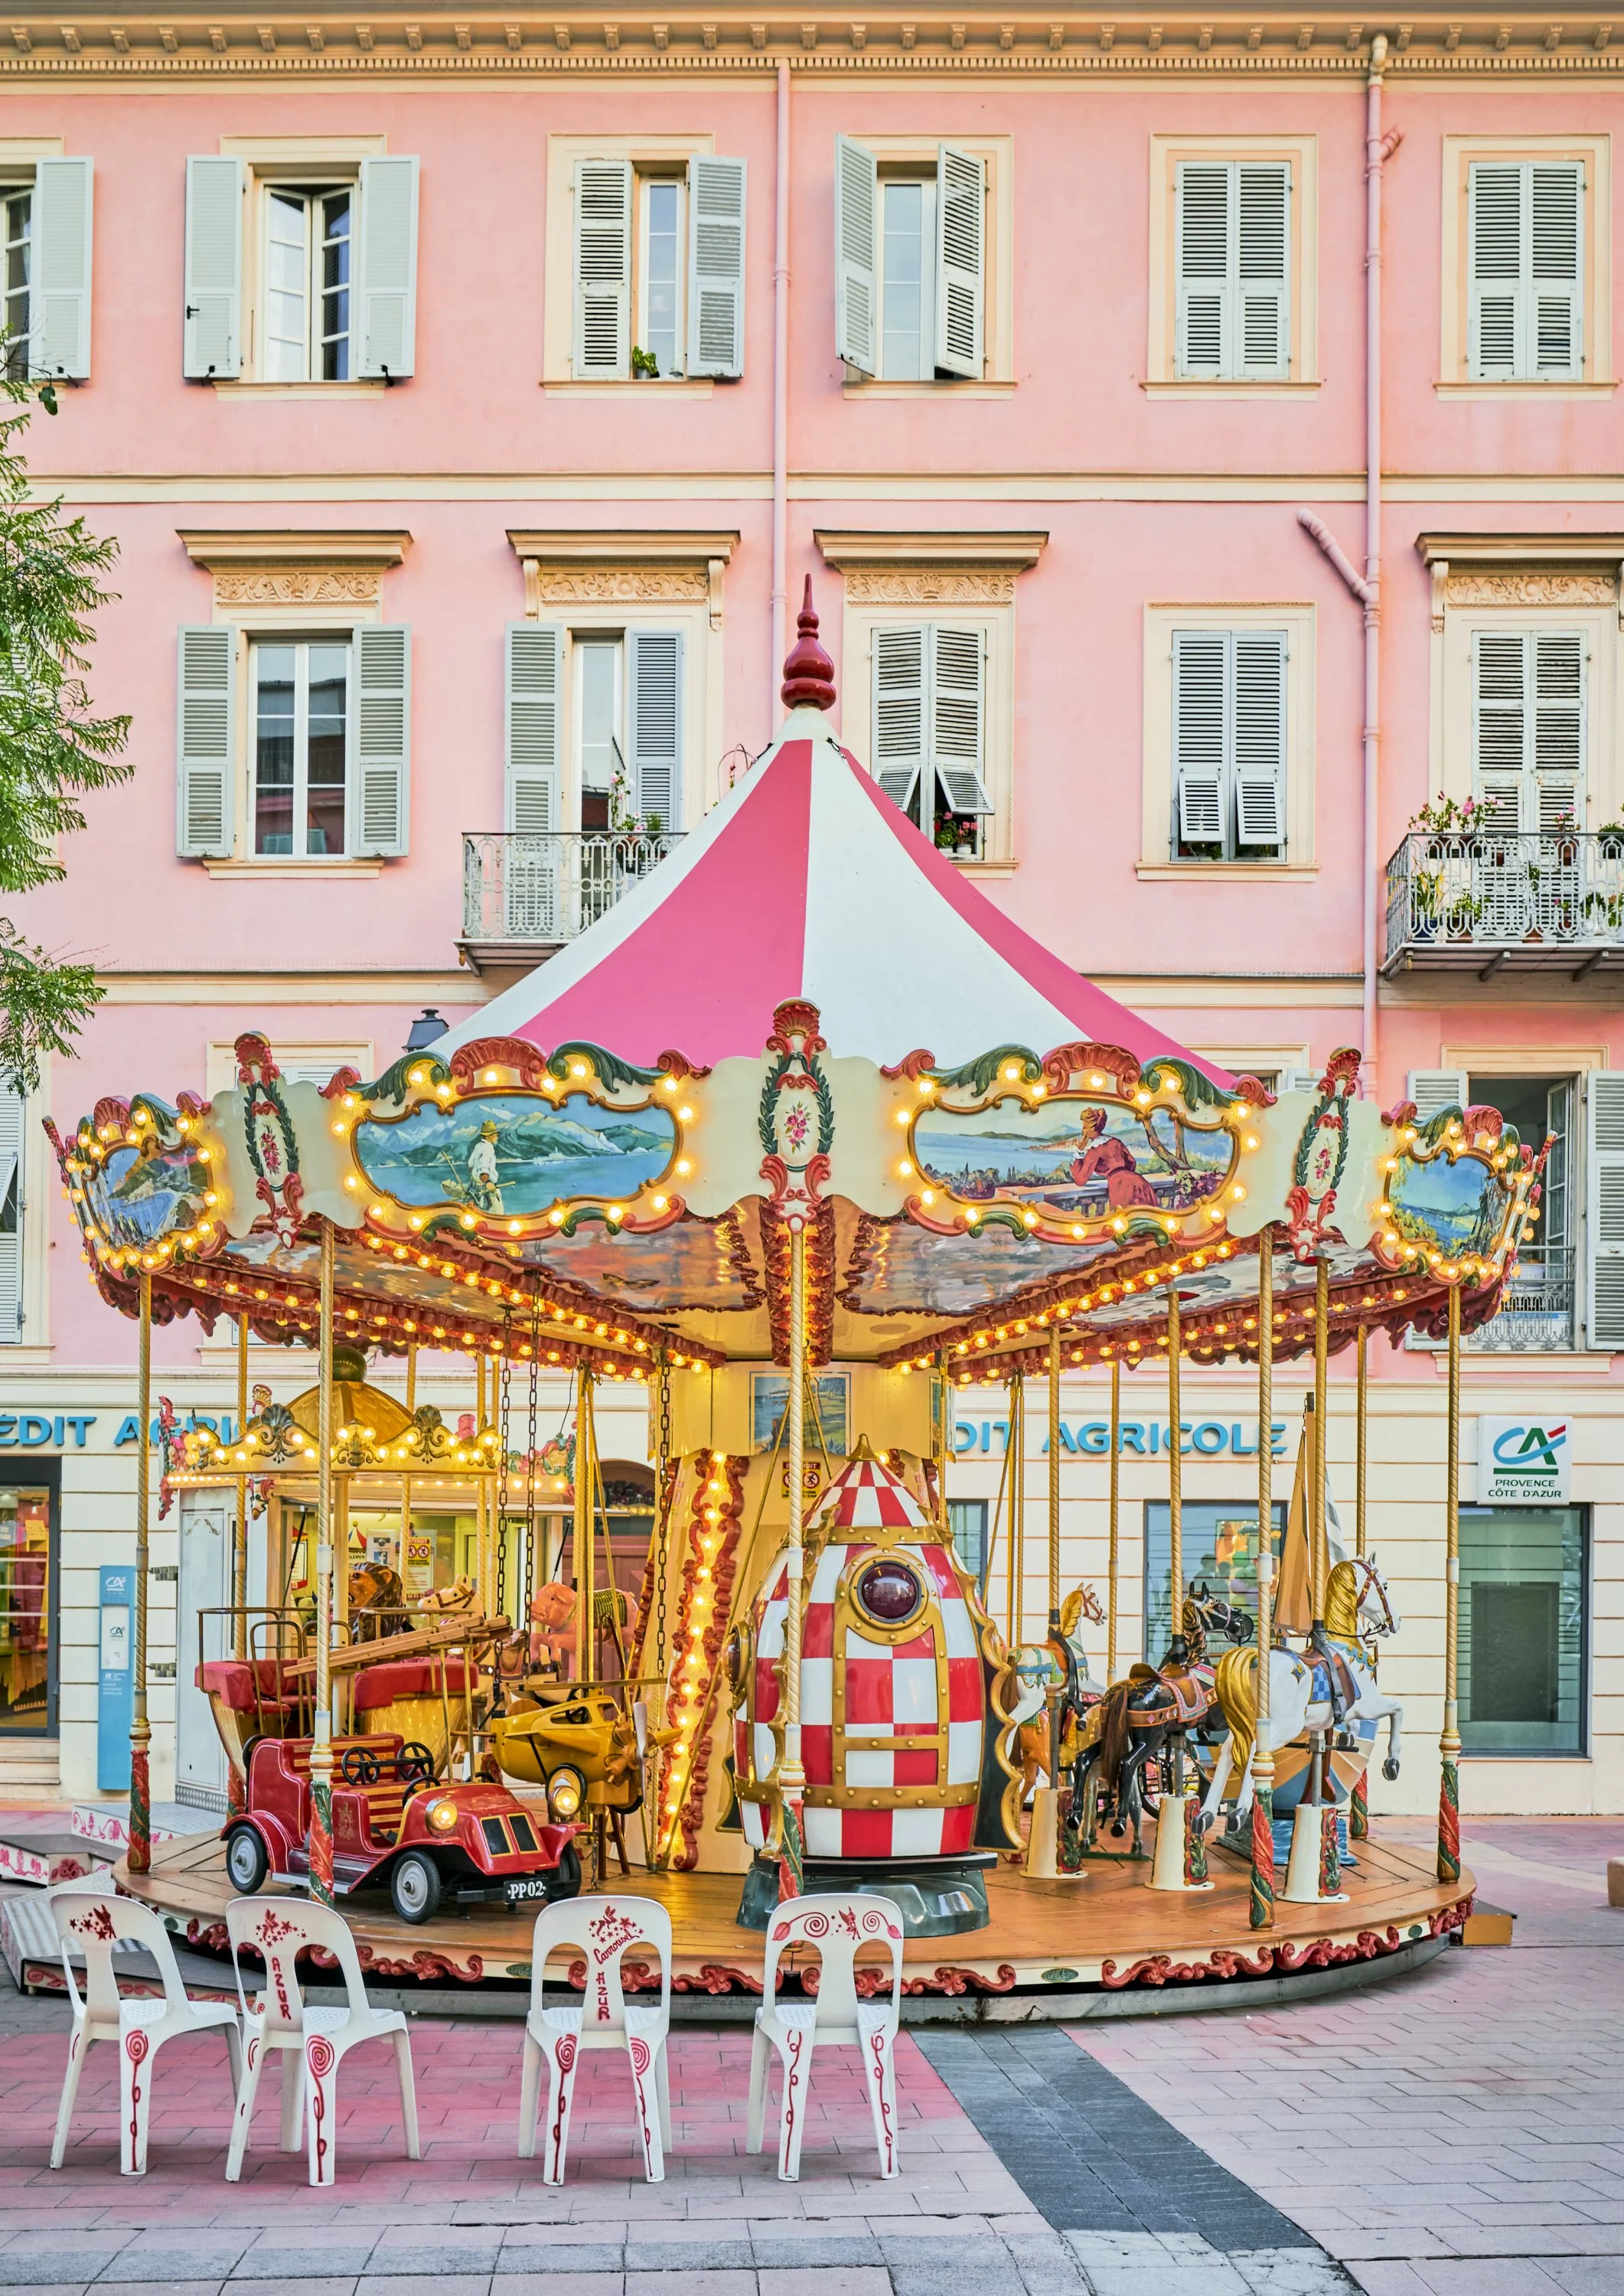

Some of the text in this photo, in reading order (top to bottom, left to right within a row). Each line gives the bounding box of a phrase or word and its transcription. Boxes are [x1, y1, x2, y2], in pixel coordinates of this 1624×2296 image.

[1488, 1488, 1518, 1497] CÔTE
[593, 1929, 641, 1965] Carrousel
[272, 1957, 292, 2020] AZUR
[596, 1971, 611, 2020] AZUR
